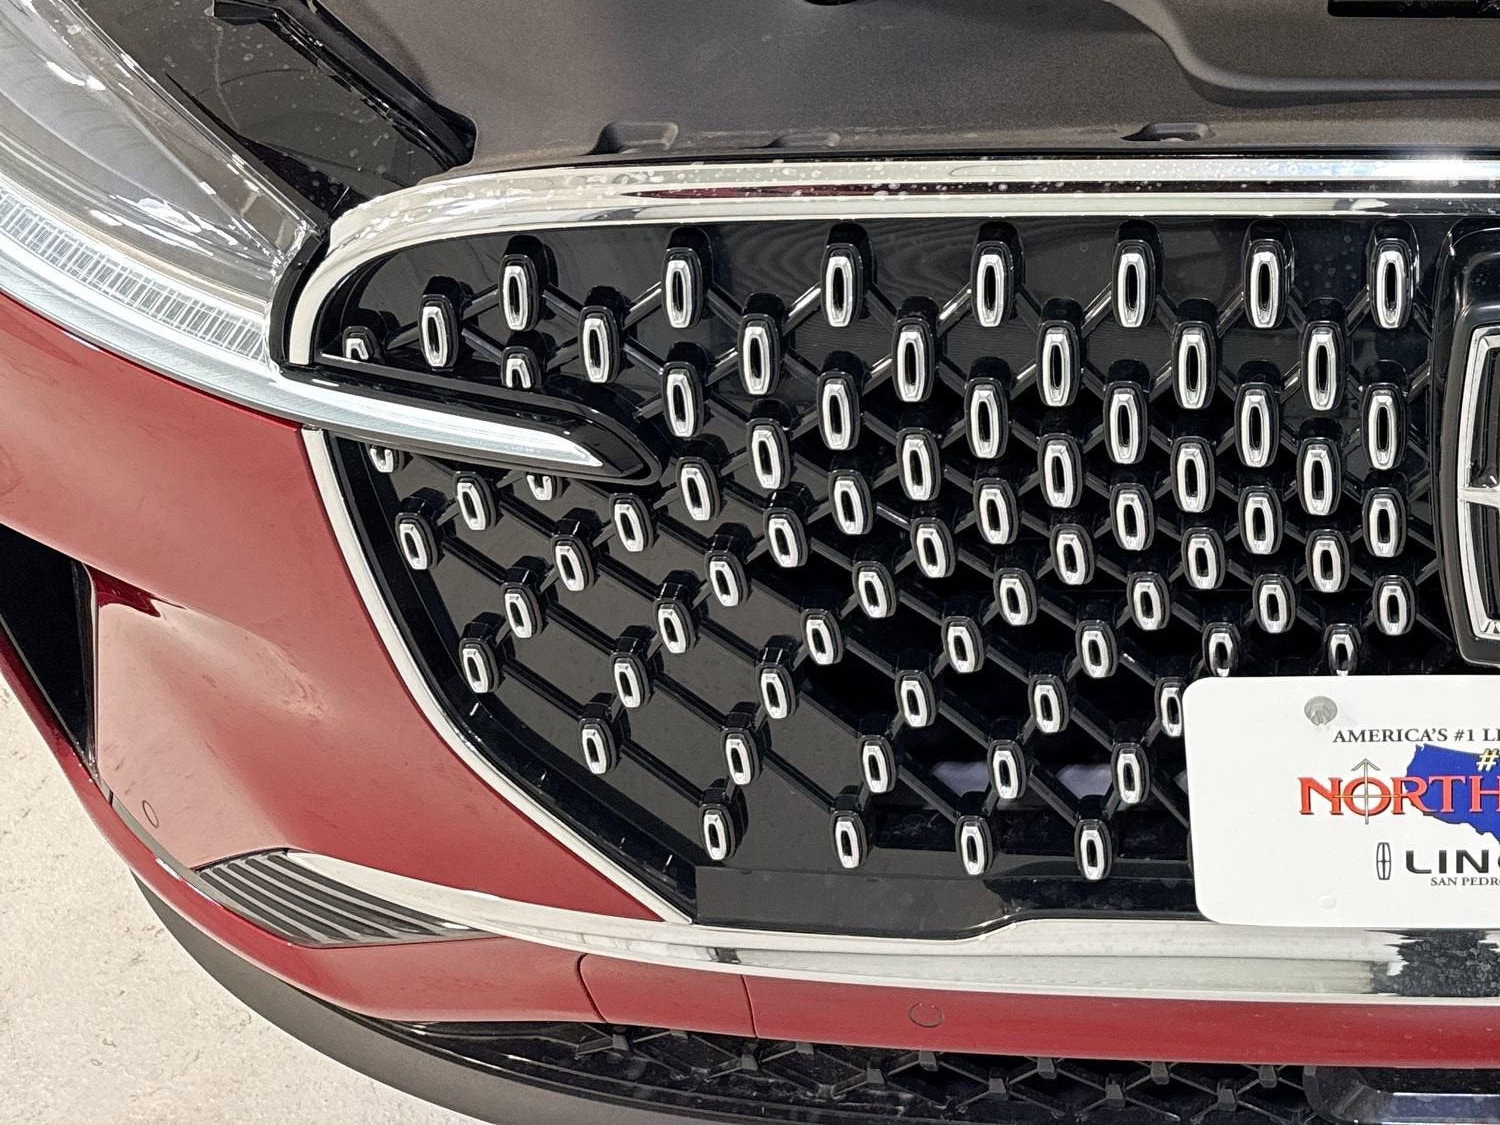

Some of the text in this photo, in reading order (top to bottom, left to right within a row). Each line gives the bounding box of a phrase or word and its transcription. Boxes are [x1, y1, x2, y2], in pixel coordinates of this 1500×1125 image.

[1332, 728, 1448, 743] AMERICA'S
[1454, 728, 1475, 742] #1
[1430, 876, 1458, 886] SAN
